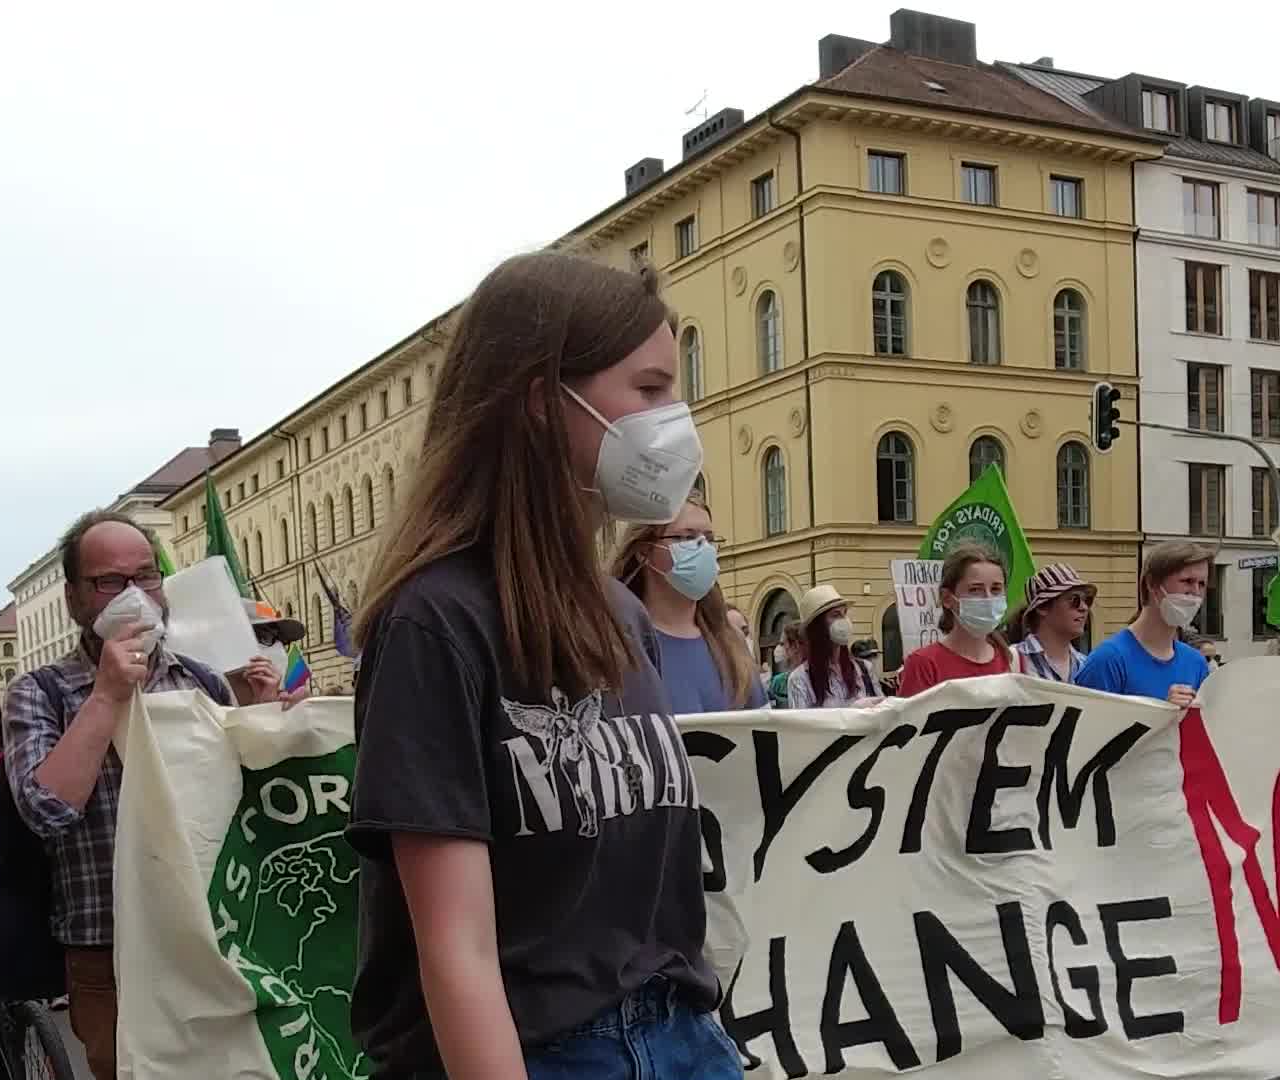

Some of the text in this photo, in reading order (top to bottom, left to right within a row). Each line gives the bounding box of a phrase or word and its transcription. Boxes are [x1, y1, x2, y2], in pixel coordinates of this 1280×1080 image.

[901, 586, 944, 608] LOV
[681, 703, 1152, 893] SYSTEM
[718, 897, 1185, 1080] HANGE
